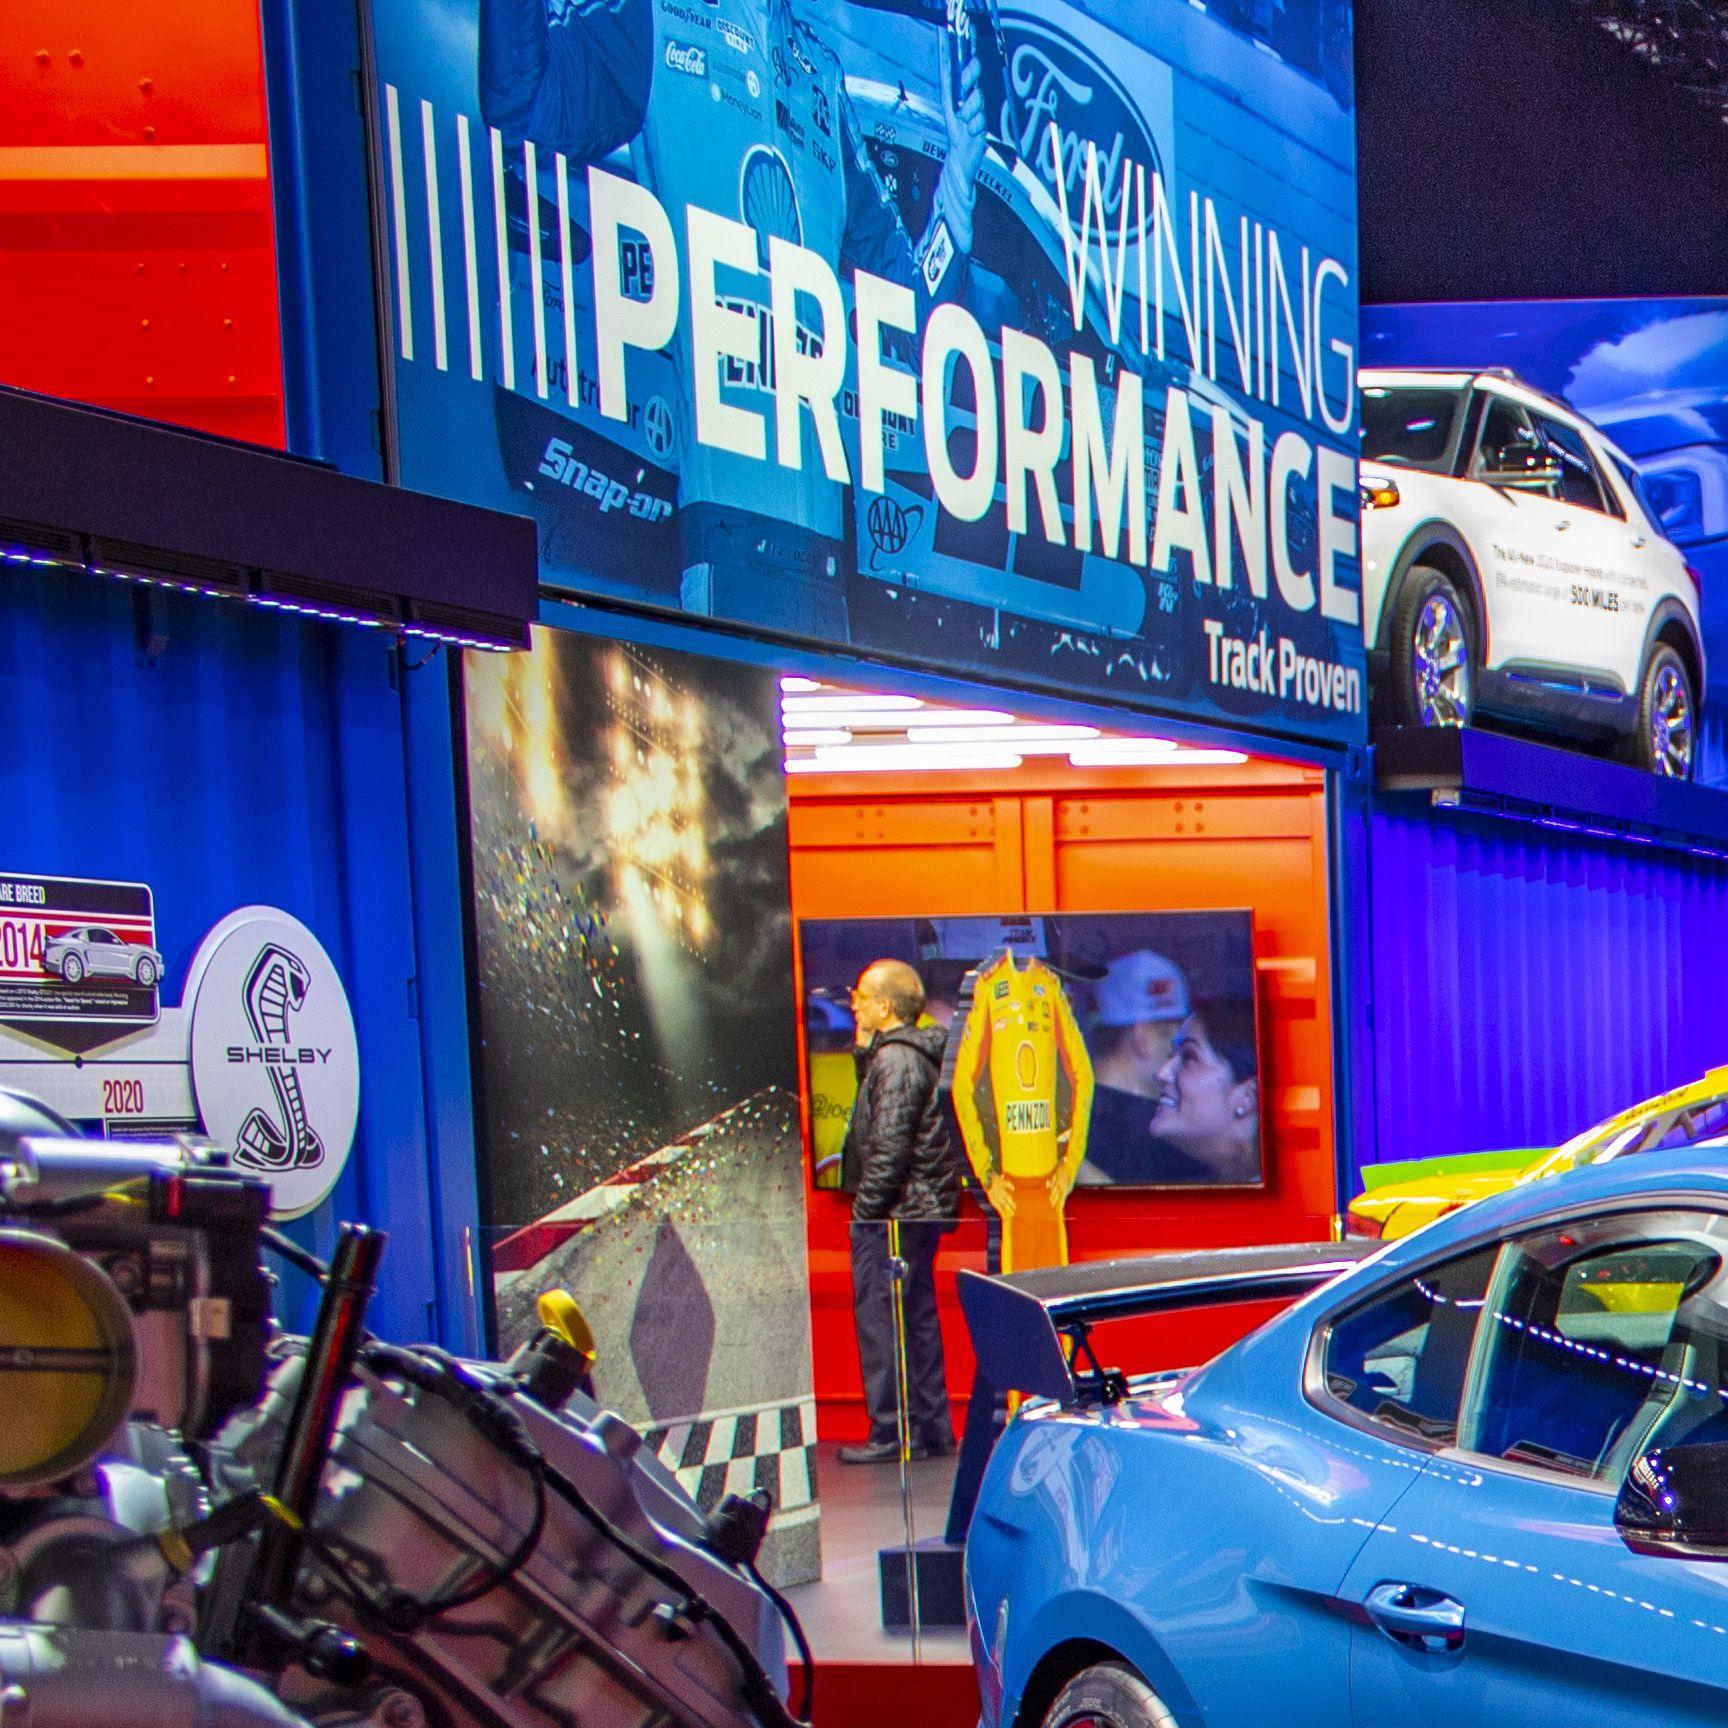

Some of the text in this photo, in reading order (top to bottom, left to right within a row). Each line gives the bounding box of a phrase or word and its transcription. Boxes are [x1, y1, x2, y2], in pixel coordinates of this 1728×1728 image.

[1049, 121, 1355, 434] WINNING
[586, 164, 1361, 626] PERFORMANCE
[537, 436, 673, 523] Snap-on
[1203, 618, 1361, 714] Track Proven
[15, 884, 46, 905] BREED
[103, 1079, 144, 1114] 2020
[226, 1046, 332, 1064] SHELBY
